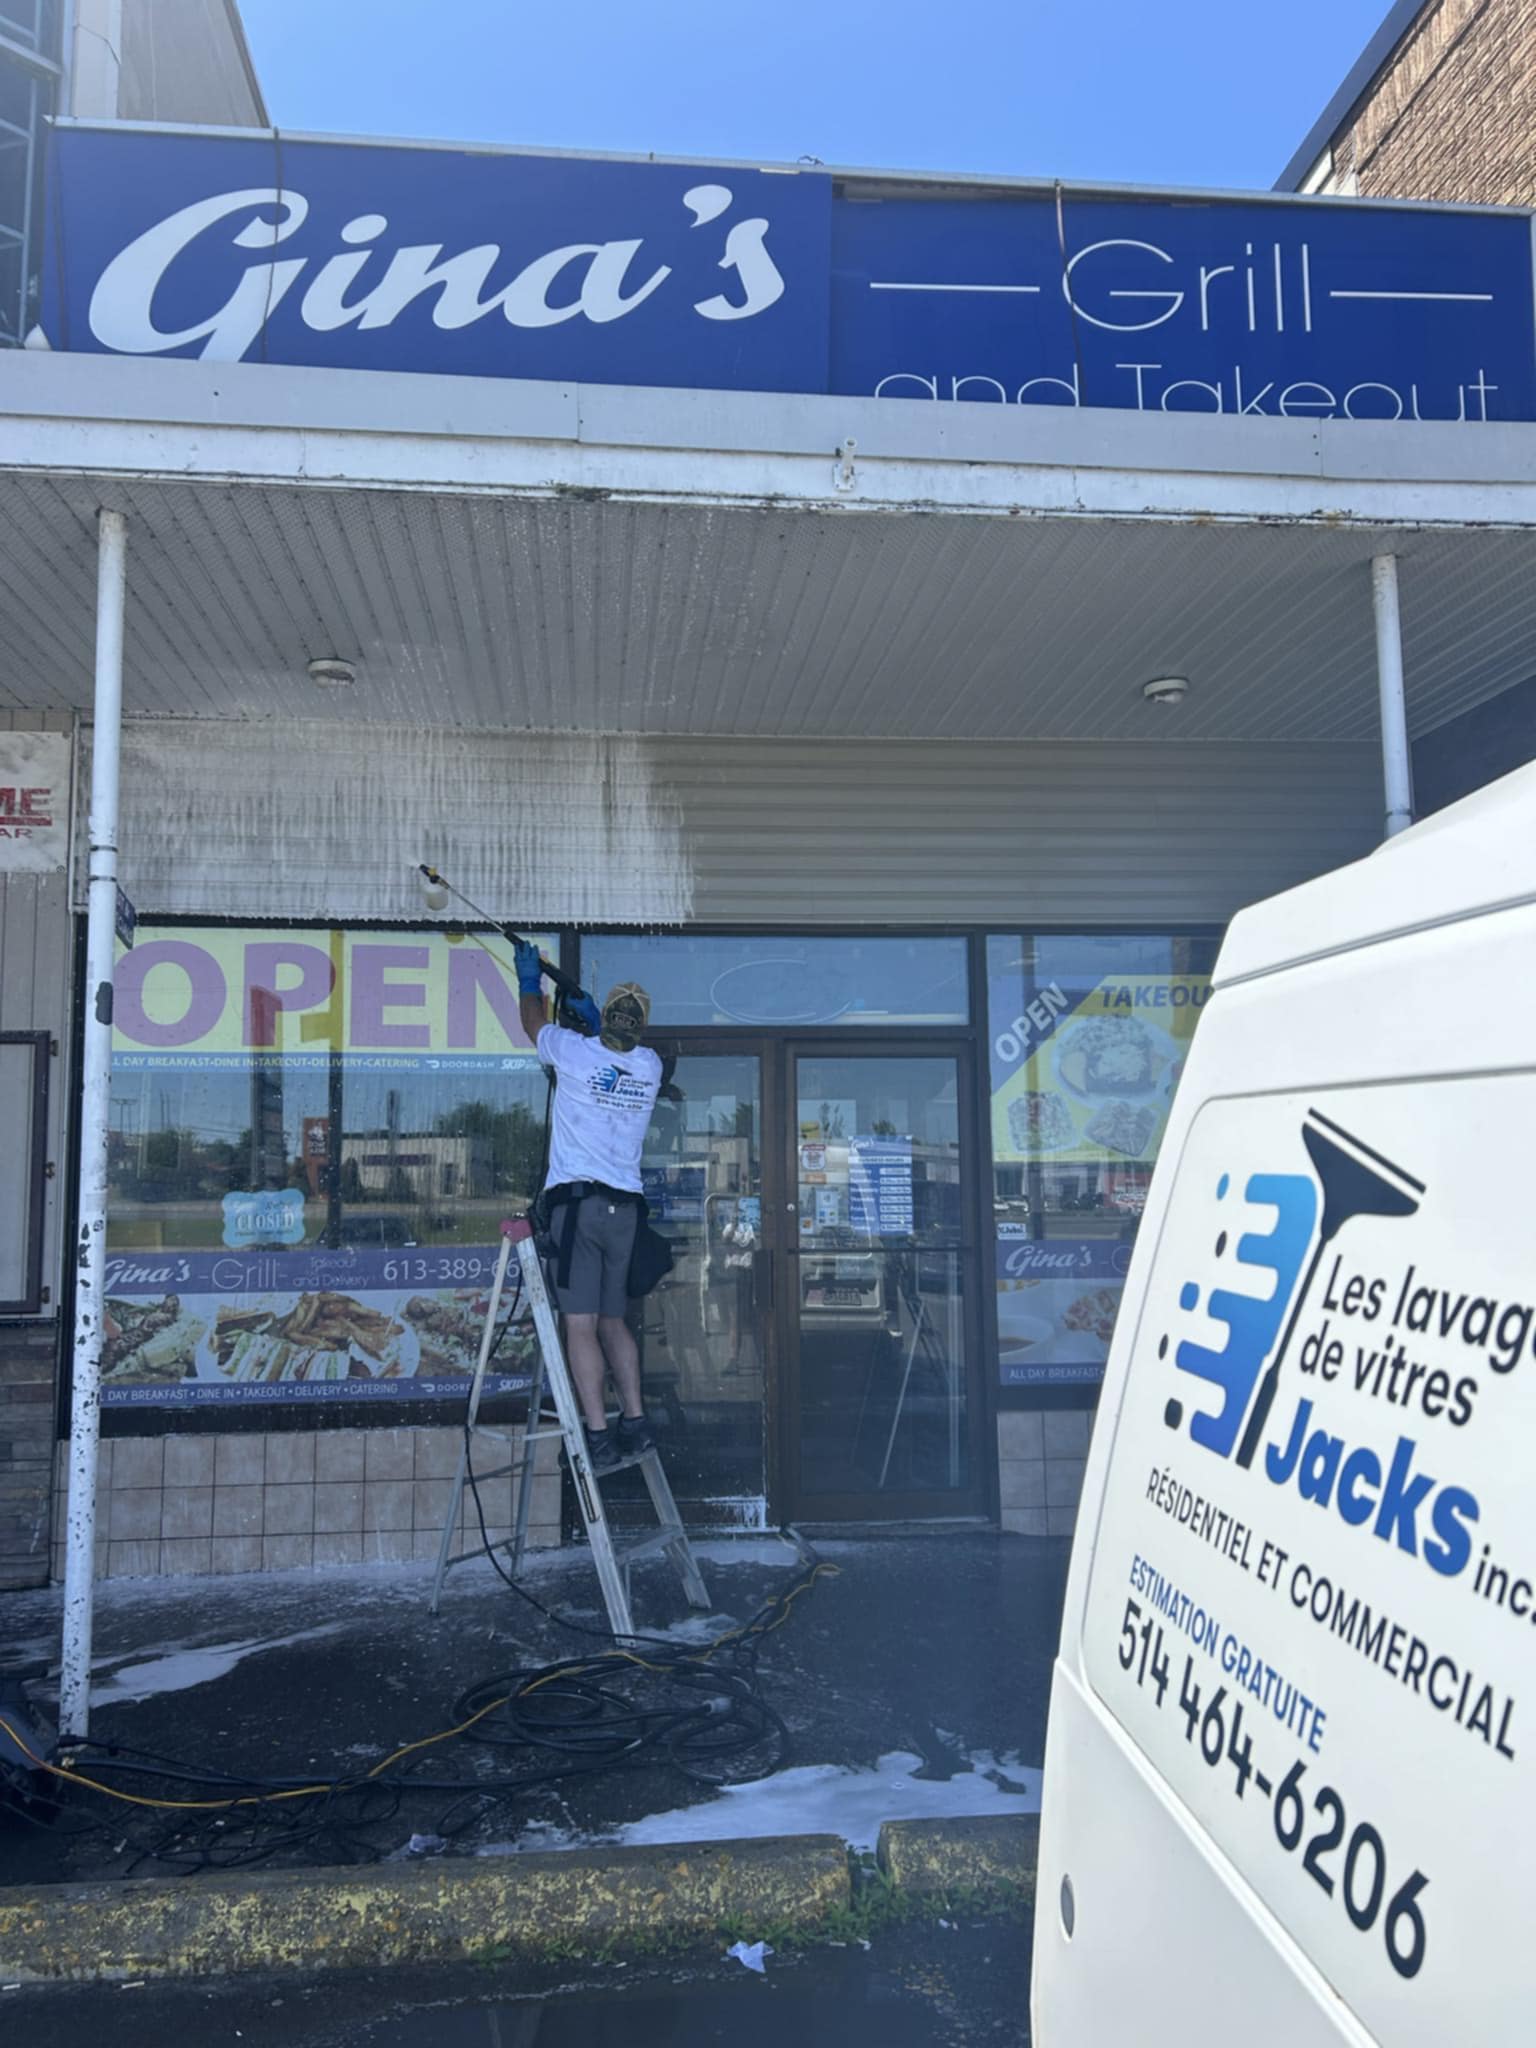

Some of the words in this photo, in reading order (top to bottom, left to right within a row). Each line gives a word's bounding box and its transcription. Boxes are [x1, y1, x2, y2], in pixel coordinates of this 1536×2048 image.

[89, 184, 785, 361] Gina's
[1063, 239, 1311, 332] Grill
[1115, 364, 1499, 422] Takeout
[113, 939, 548, 1048] OPEN
[994, 982, 1069, 1063] OPEN
[1101, 985, 1215, 1008] TAKEOU
[104, 1258, 190, 1292] Gina's
[212, 1258, 277, 1289] Grill
[383, 1257, 520, 1281] 613-389-66
[1005, 1245, 1092, 1277] Gina's
[1321, 1254, 1387, 1321] Les
[1393, 1265, 1536, 1374] lavag
[107, 1390, 128, 1401] DAY
[131, 1388, 188, 1401] BREAKFAST
[197, 1387, 221, 1399] DINE
[223, 1387, 235, 1399] IN
[243, 1386, 287, 1398] TAKEOUT
[294, 1384, 342, 1397] DELIVERY
[350, 1383, 399, 1395] CATERING
[1009, 1368, 1027, 1380] ALL
[1028, 1367, 1045, 1379] DAY
[1049, 1366, 1100, 1378] BREAKFAST
[1300, 1319, 1344, 1382] de
[1354, 1333, 1479, 1427] vitres
[1264, 1397, 1480, 1577] Jacks
[1128, 1554, 1219, 1657] ESTIMATION
[1221, 1633, 1327, 1755] GRATUITE
[1146, 1466, 1253, 1571] RÉSIDENTIEL
[1257, 1540, 1288, 1592] ET
[1290, 1563, 1515, 1761] COMMERCIAL
[1118, 1596, 1170, 1709] 514
[1179, 1654, 1430, 1980] 464-6206
